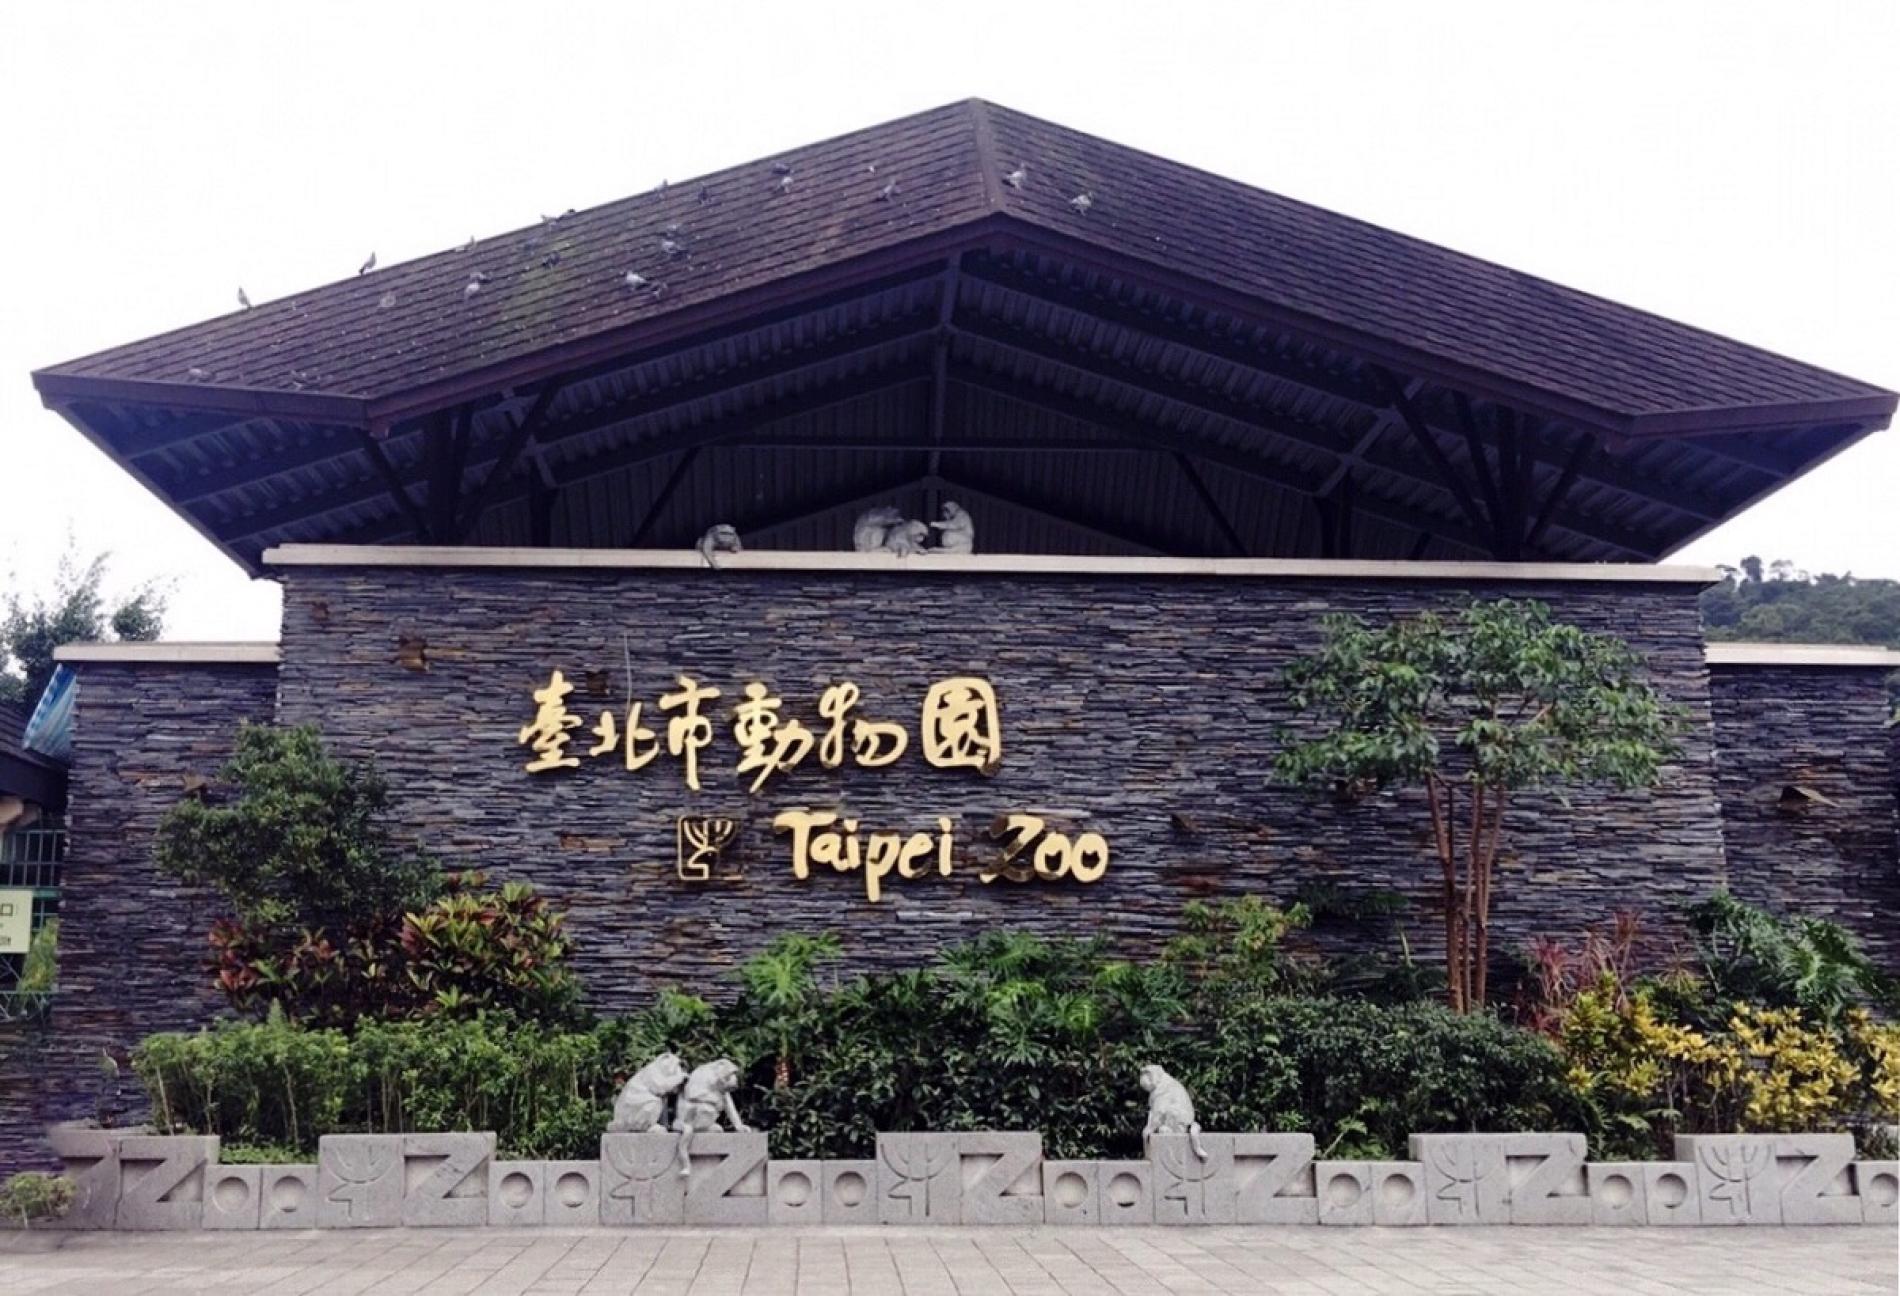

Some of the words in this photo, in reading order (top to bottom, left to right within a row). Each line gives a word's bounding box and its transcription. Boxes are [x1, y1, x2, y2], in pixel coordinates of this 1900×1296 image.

[519, 669, 1001, 794] 臺北市動物園
[773, 810, 953, 903] Taipei
[979, 813, 1109, 884] Zoo
